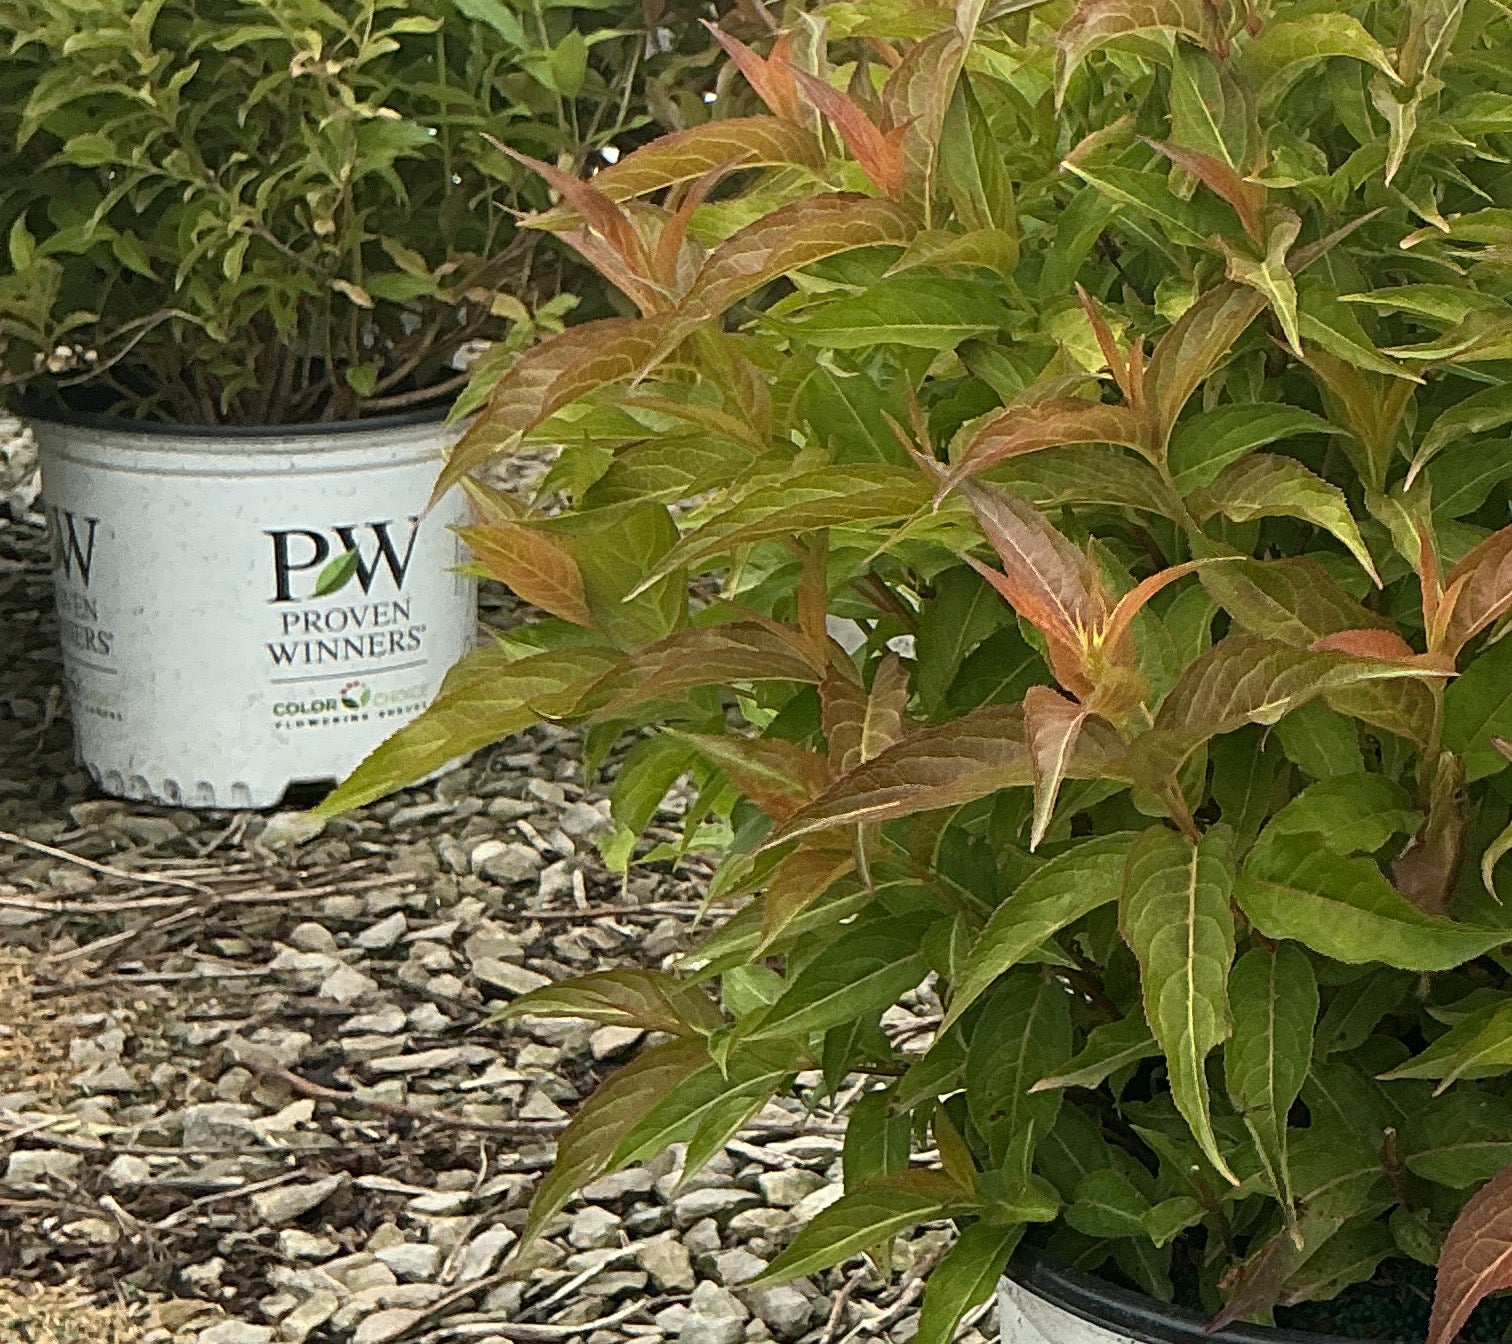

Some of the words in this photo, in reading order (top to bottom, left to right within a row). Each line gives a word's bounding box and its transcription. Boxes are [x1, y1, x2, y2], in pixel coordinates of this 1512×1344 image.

[264, 514, 421, 604] PW
[281, 597, 412, 635] PROVEN
[273, 698, 338, 717] COLOR
